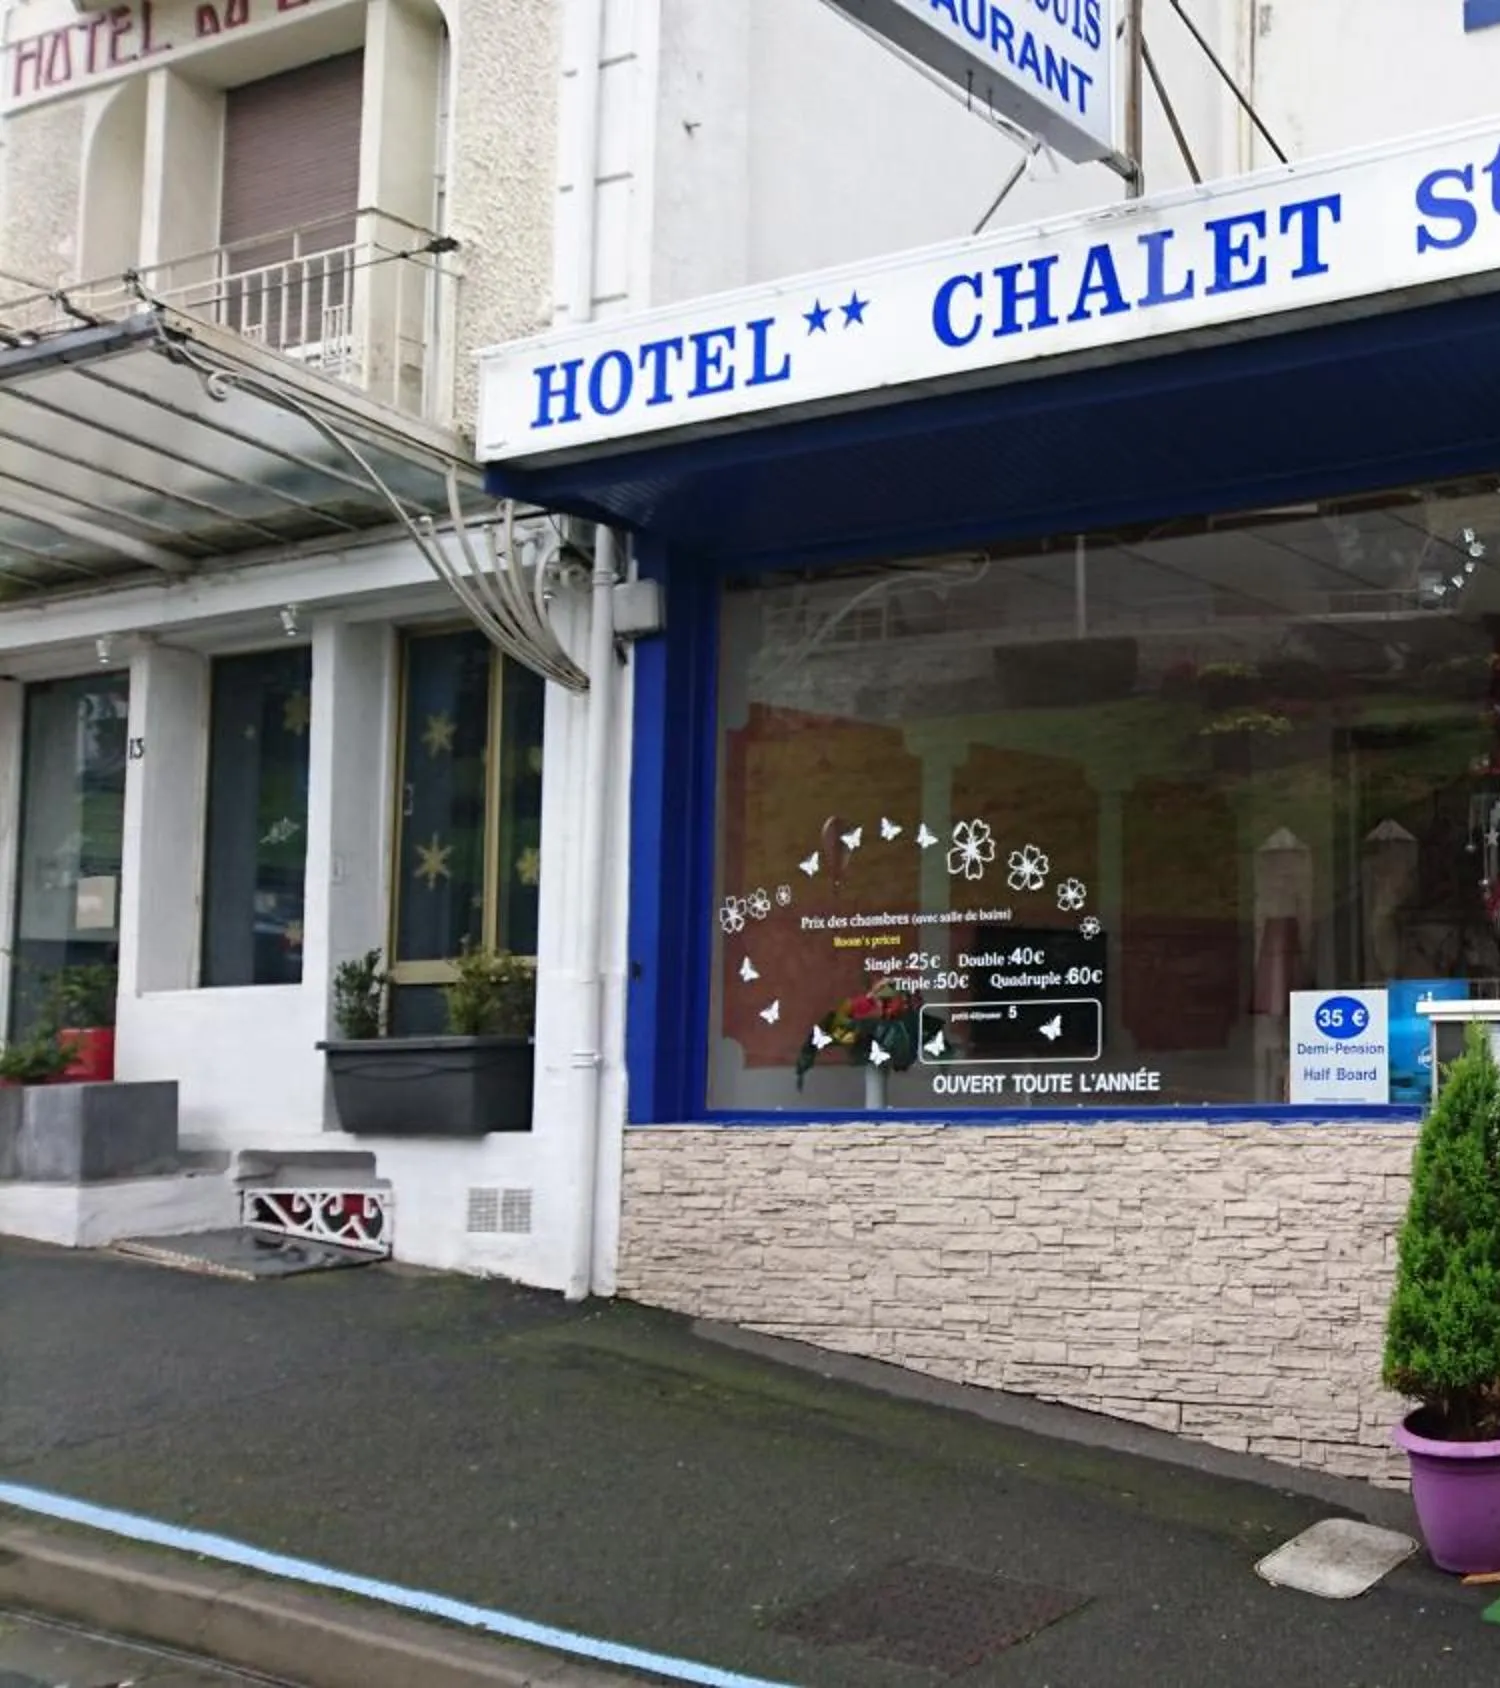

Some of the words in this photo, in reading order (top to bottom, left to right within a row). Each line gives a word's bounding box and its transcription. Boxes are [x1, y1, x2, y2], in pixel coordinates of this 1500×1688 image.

[1034, 0, 1101, 50] UIS
[530, 316, 793, 429] HOTEL
[930, 193, 1342, 349] CHALET
[800, 915, 825, 929] Prix
[827, 914, 848, 929] des
[849, 911, 909, 927] chambres
[965, 909, 978, 921] de
[864, 957, 902, 974] Single
[958, 953, 1005, 968] Double
[893, 975, 931, 993] Triple
[990, 972, 1062, 989] Quadruple
[1319, 1009, 1343, 1027] 35
[1351, 1009, 1366, 1027] €
[1297, 1042, 1385, 1056] Demi-Pension
[933, 1074, 1006, 1093] OUVERT
[1011, 1073, 1073, 1093] TOUTE
[1079, 1067, 1161, 1092] L'ANNÉE
[1303, 1067, 1331, 1081] Half
[1337, 1067, 1377, 1081] Board
